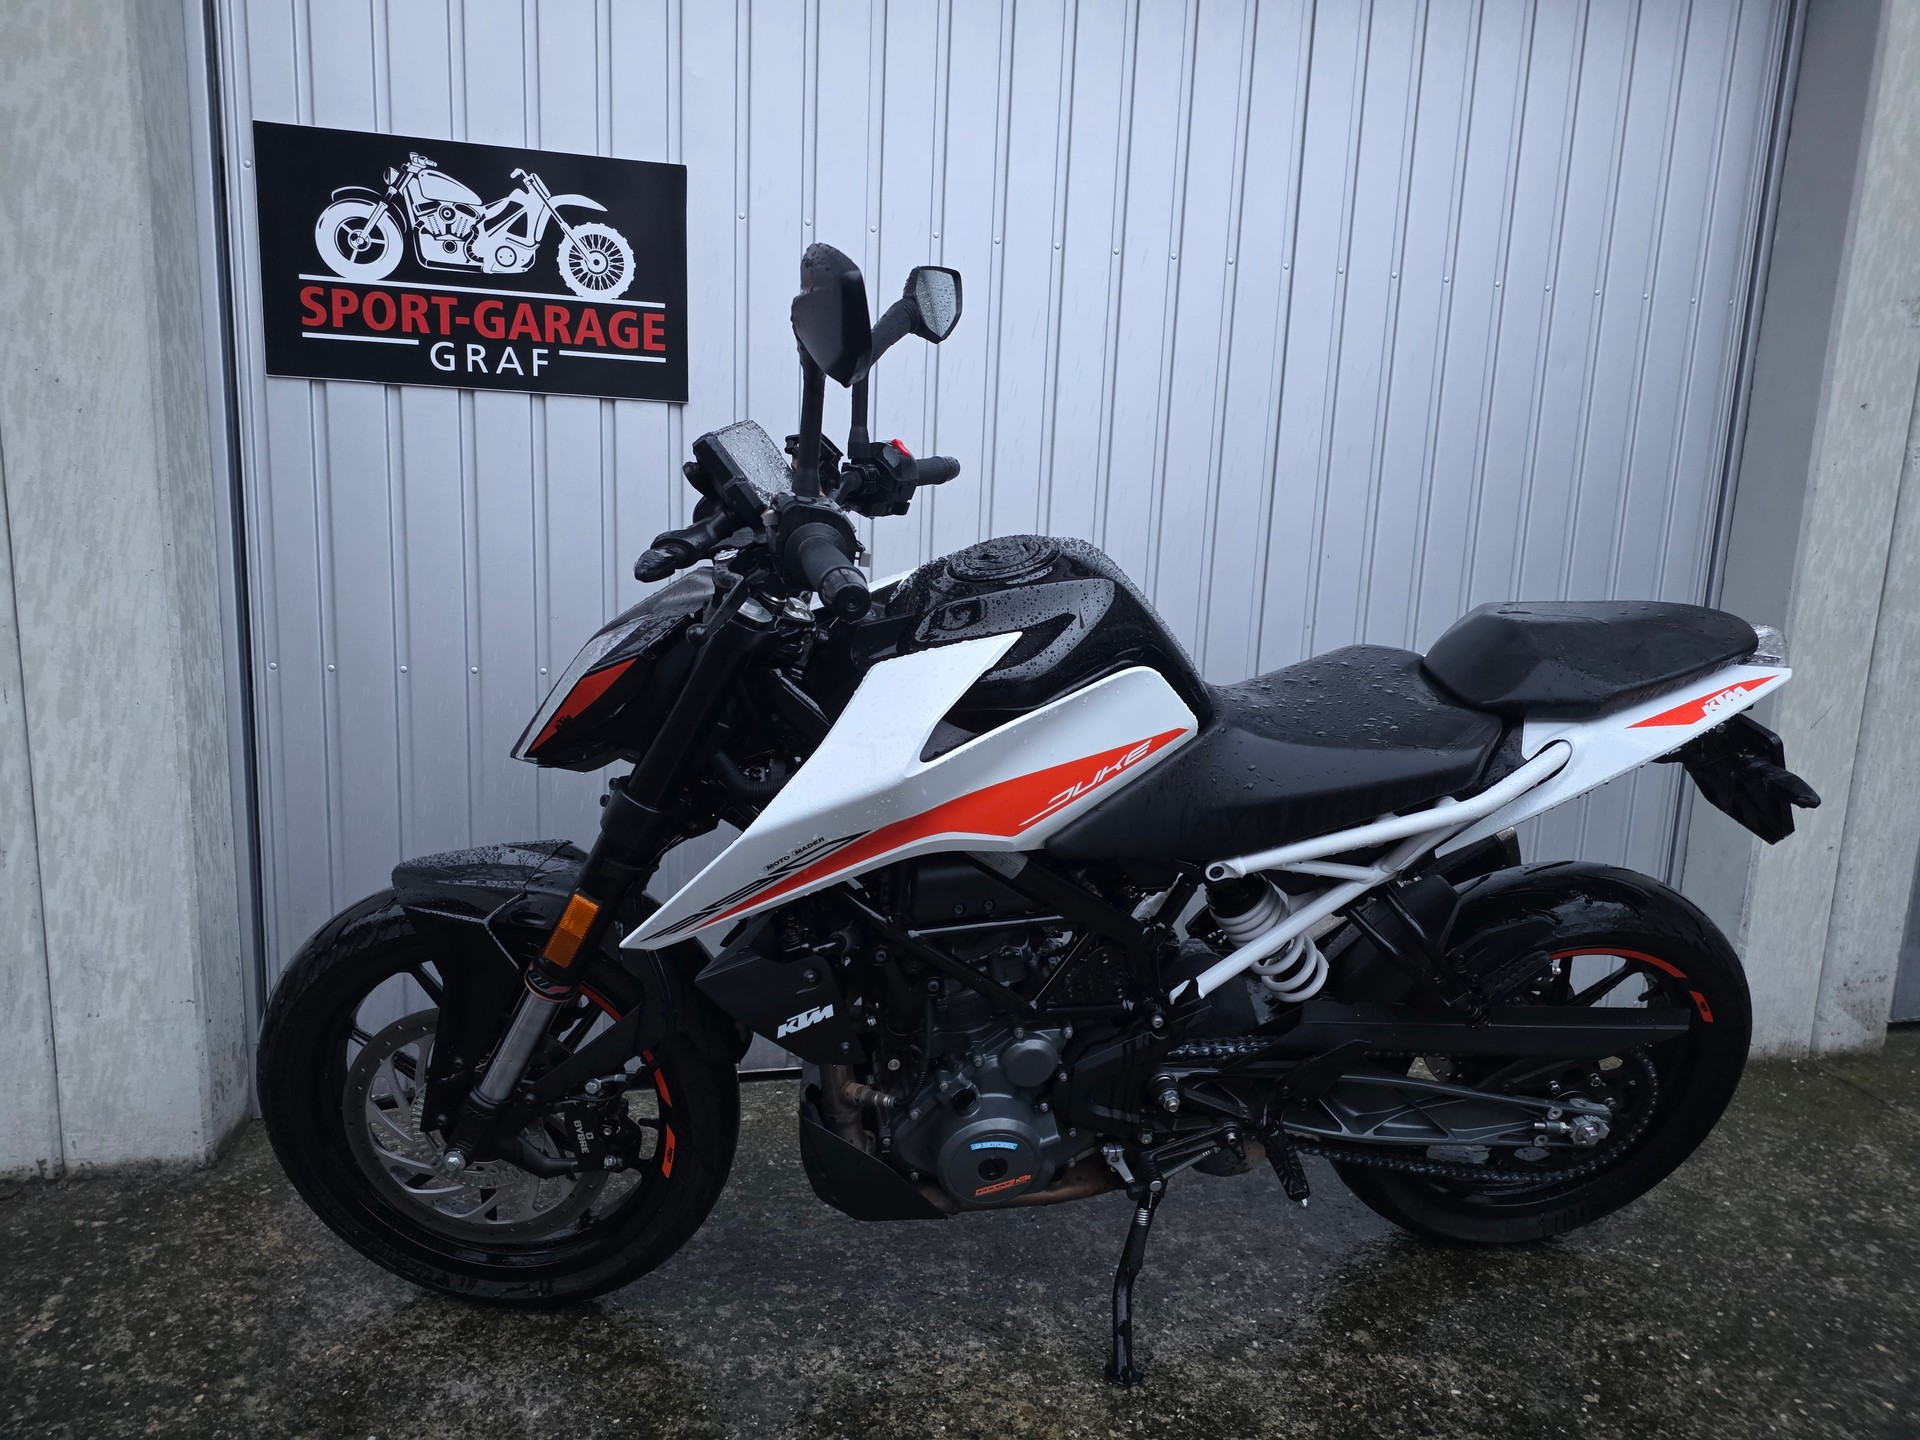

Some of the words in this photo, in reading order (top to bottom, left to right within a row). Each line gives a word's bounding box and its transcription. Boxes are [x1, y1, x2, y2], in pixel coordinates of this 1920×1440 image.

[300, 286, 666, 351] SPORT-GARAGE
[430, 341, 549, 377] GRAF
[1701, 686, 1749, 716] KTM
[1018, 739, 1152, 826] DUKE
[764, 855, 790, 871] MOTO
[792, 837, 825, 857] MADER
[777, 1003, 834, 1039] KTM
[573, 1120, 590, 1154] BYBRE
